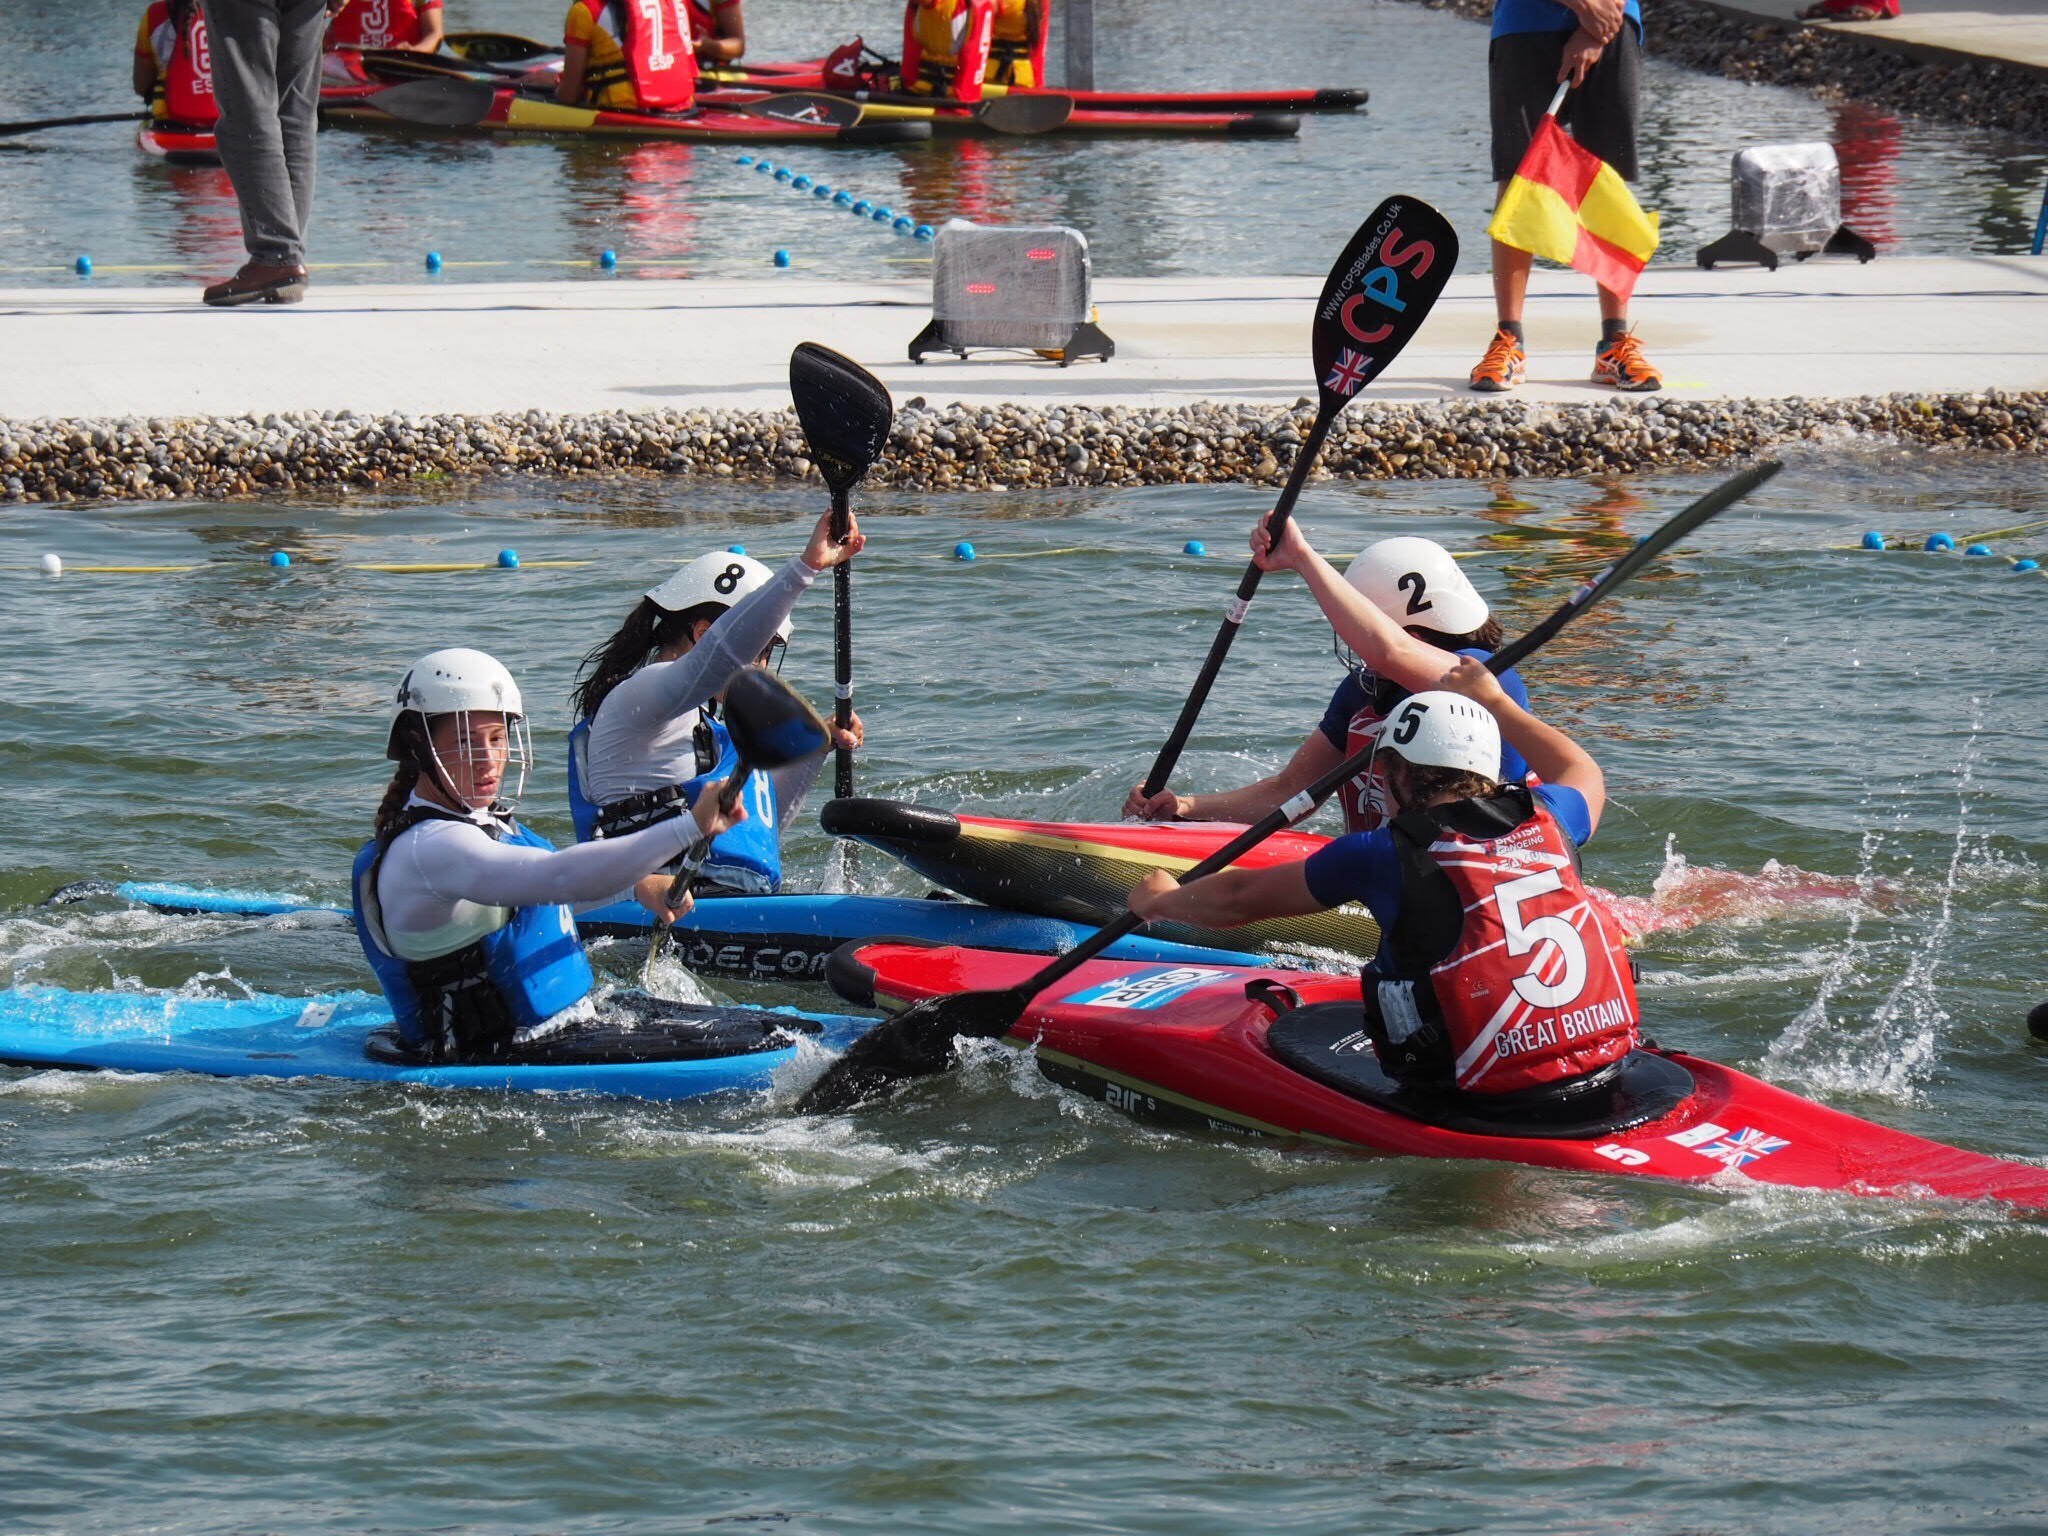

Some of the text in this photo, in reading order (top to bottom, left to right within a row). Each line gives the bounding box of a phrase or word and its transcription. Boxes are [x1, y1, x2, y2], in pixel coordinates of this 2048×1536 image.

[360, 33, 394, 49] ESP
[648, 54, 675, 72] ESP
[191, 79, 215, 94] ES
[1340, 227, 1436, 343] CPS
[713, 563, 746, 595] 8
[1397, 571, 1433, 616] 2
[396, 669, 415, 708] 4
[1393, 701, 1431, 745] 5
[1494, 824, 1542, 846] BRITISH
[1493, 866, 1588, 1010] 5
[1100, 971, 1201, 1002] GBR
[1494, 998, 1626, 1059] GREAT BRITAIN
[1594, 1143, 1651, 1166] 5
